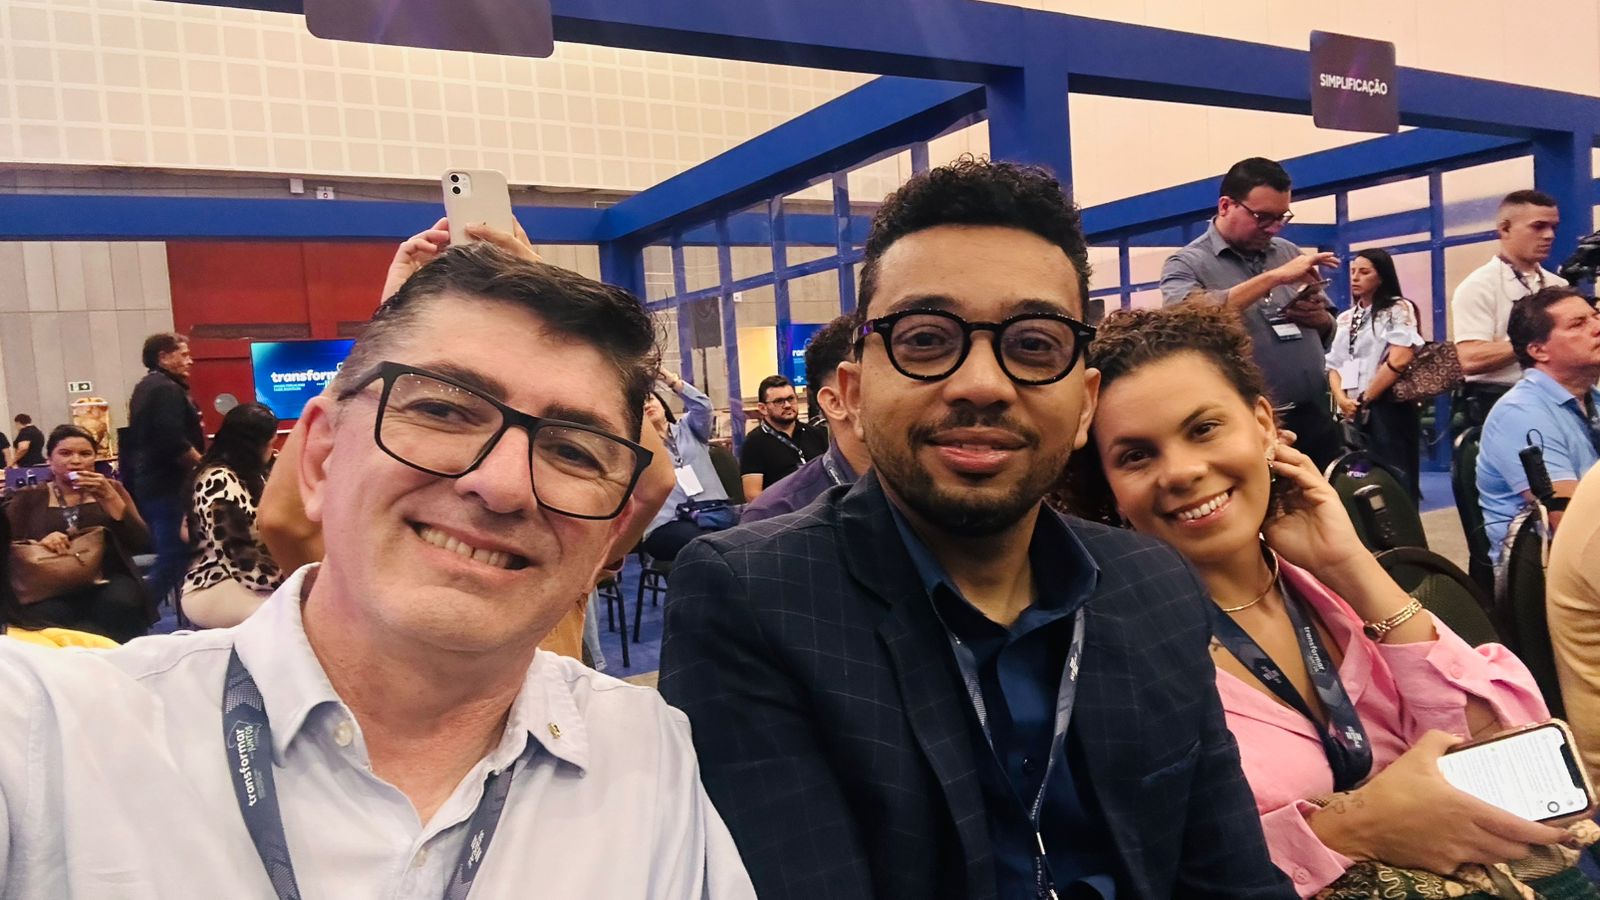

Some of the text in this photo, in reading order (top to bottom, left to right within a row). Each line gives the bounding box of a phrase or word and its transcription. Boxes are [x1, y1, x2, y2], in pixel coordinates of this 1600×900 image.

[1320, 73, 1388, 96] SIMPLIFICAÇÃO
[270, 369, 338, 383] transform
[236, 729, 257, 807] transformar
